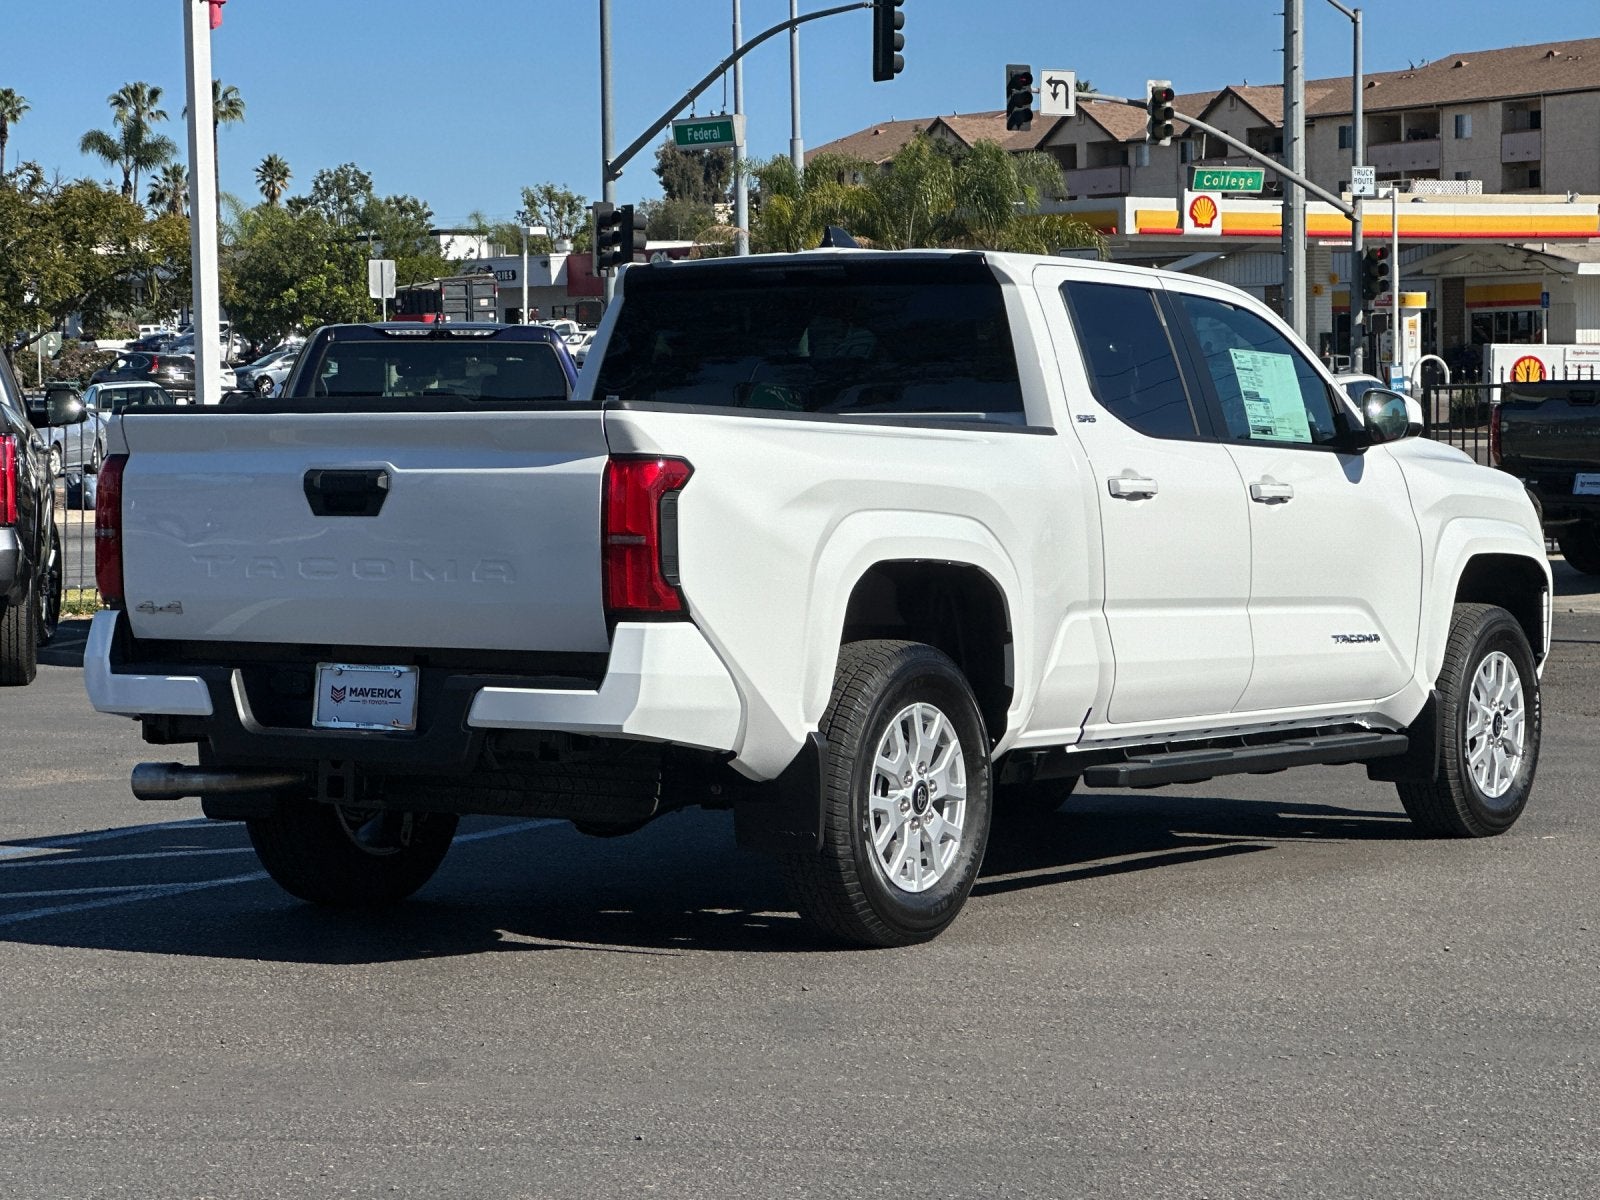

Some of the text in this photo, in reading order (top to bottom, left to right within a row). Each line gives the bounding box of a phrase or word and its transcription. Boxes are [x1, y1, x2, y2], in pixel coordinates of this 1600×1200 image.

[687, 125, 720, 141] Federal
[1203, 174, 1253, 189] College
[1353, 177, 1374, 185] ROUTE
[190, 554, 515, 584] TACOMA
[1331, 633, 1380, 644] TACOMA
[349, 687, 402, 699] MAVERICK
